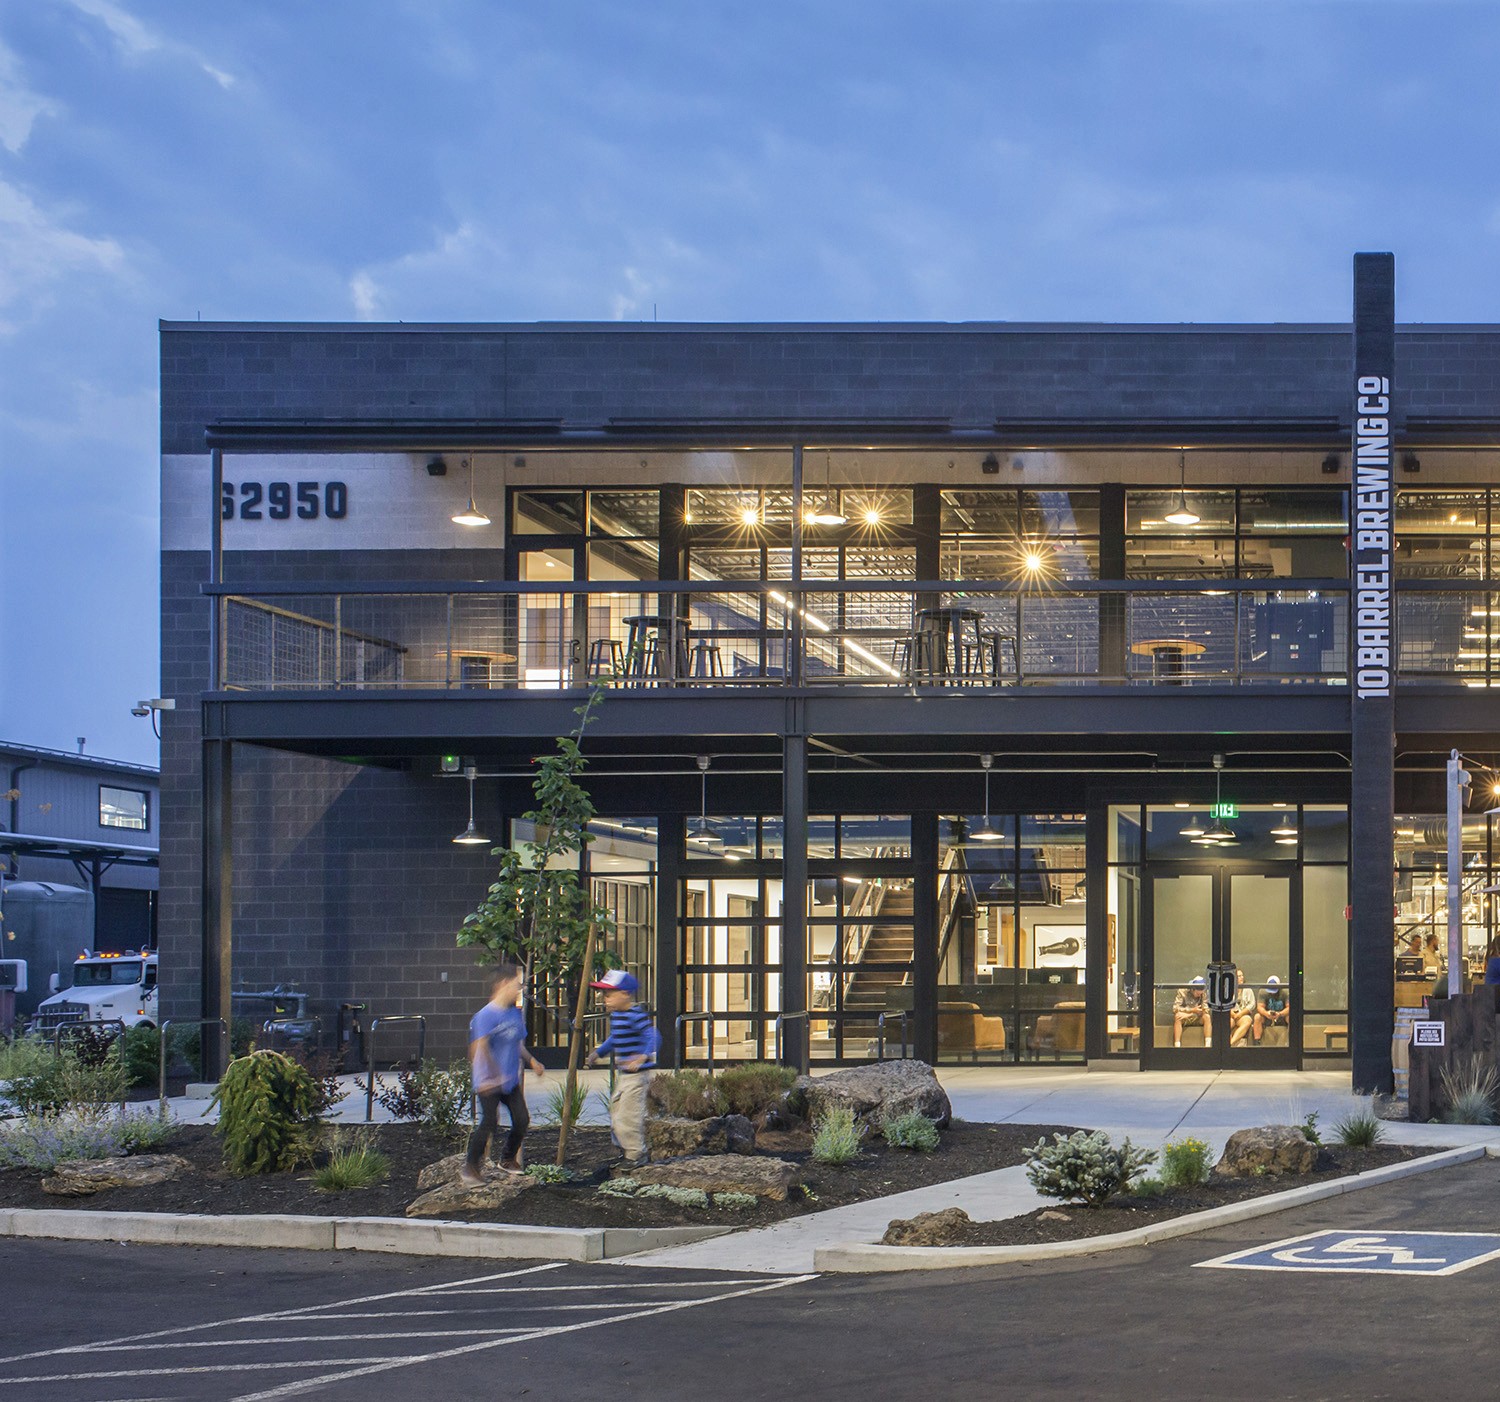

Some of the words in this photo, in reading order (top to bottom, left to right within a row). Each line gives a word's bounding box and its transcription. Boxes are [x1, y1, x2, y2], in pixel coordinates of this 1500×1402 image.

[1357, 417, 1390, 550] BREWING
[1357, 553, 1390, 667] BARREL
[1208, 972, 1235, 1004] 10
